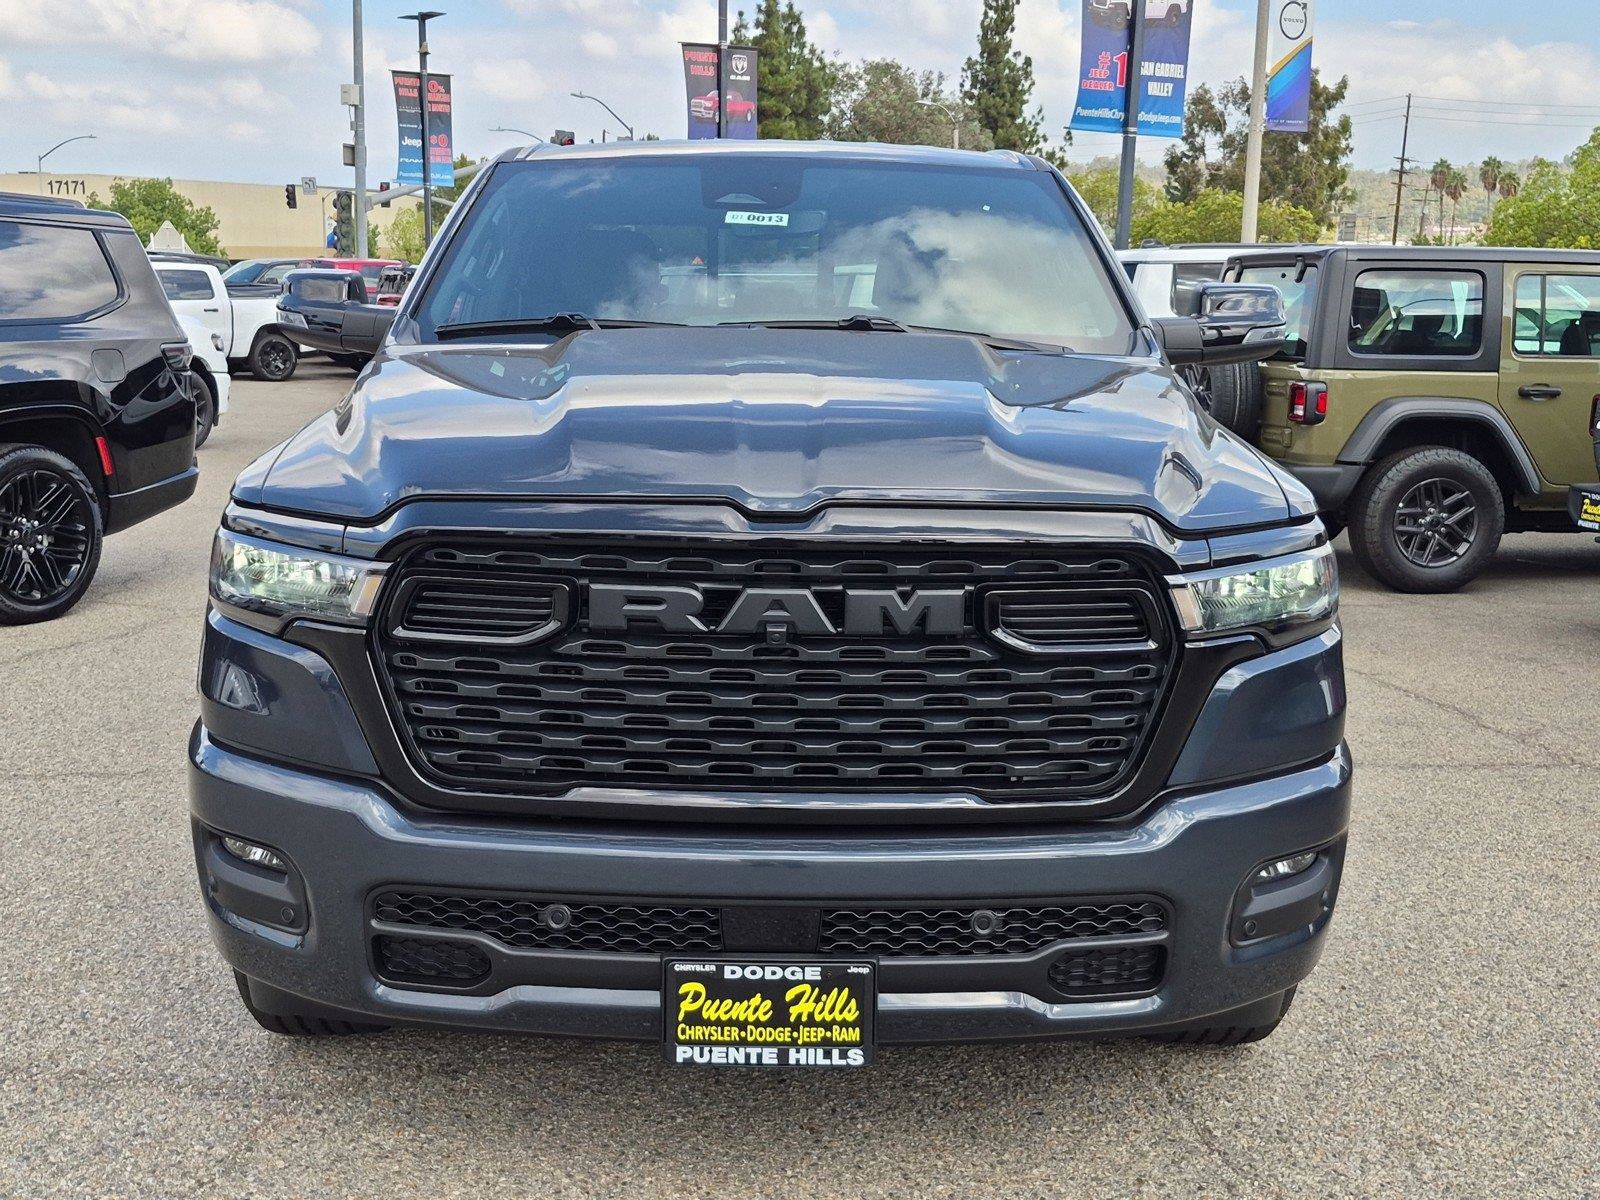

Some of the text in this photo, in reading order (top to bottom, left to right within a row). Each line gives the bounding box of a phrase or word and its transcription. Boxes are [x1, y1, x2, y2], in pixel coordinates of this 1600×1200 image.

[684, 51, 718, 63] PUENTE
[690, 64, 715, 77] HILLS
[1088, 68, 1110, 79] JEEP
[1155, 62, 1185, 79] GABRIEL
[1081, 79, 1115, 91] DEALER
[1147, 81, 1174, 97] VALLEY
[399, 87, 418, 97] HILLS
[401, 136, 422, 148] Jeep
[47, 180, 86, 195] 17171
[747, 213, 784, 223] 0013
[589, 582, 966, 636] RAM
[674, 964, 716, 972] CHRYSLER
[723, 965, 822, 981] DODGE
[847, 965, 870, 974] Jeep
[677, 981, 860, 1022] Puente Hills
[676, 1046, 865, 1066] PUENTE HILLS
